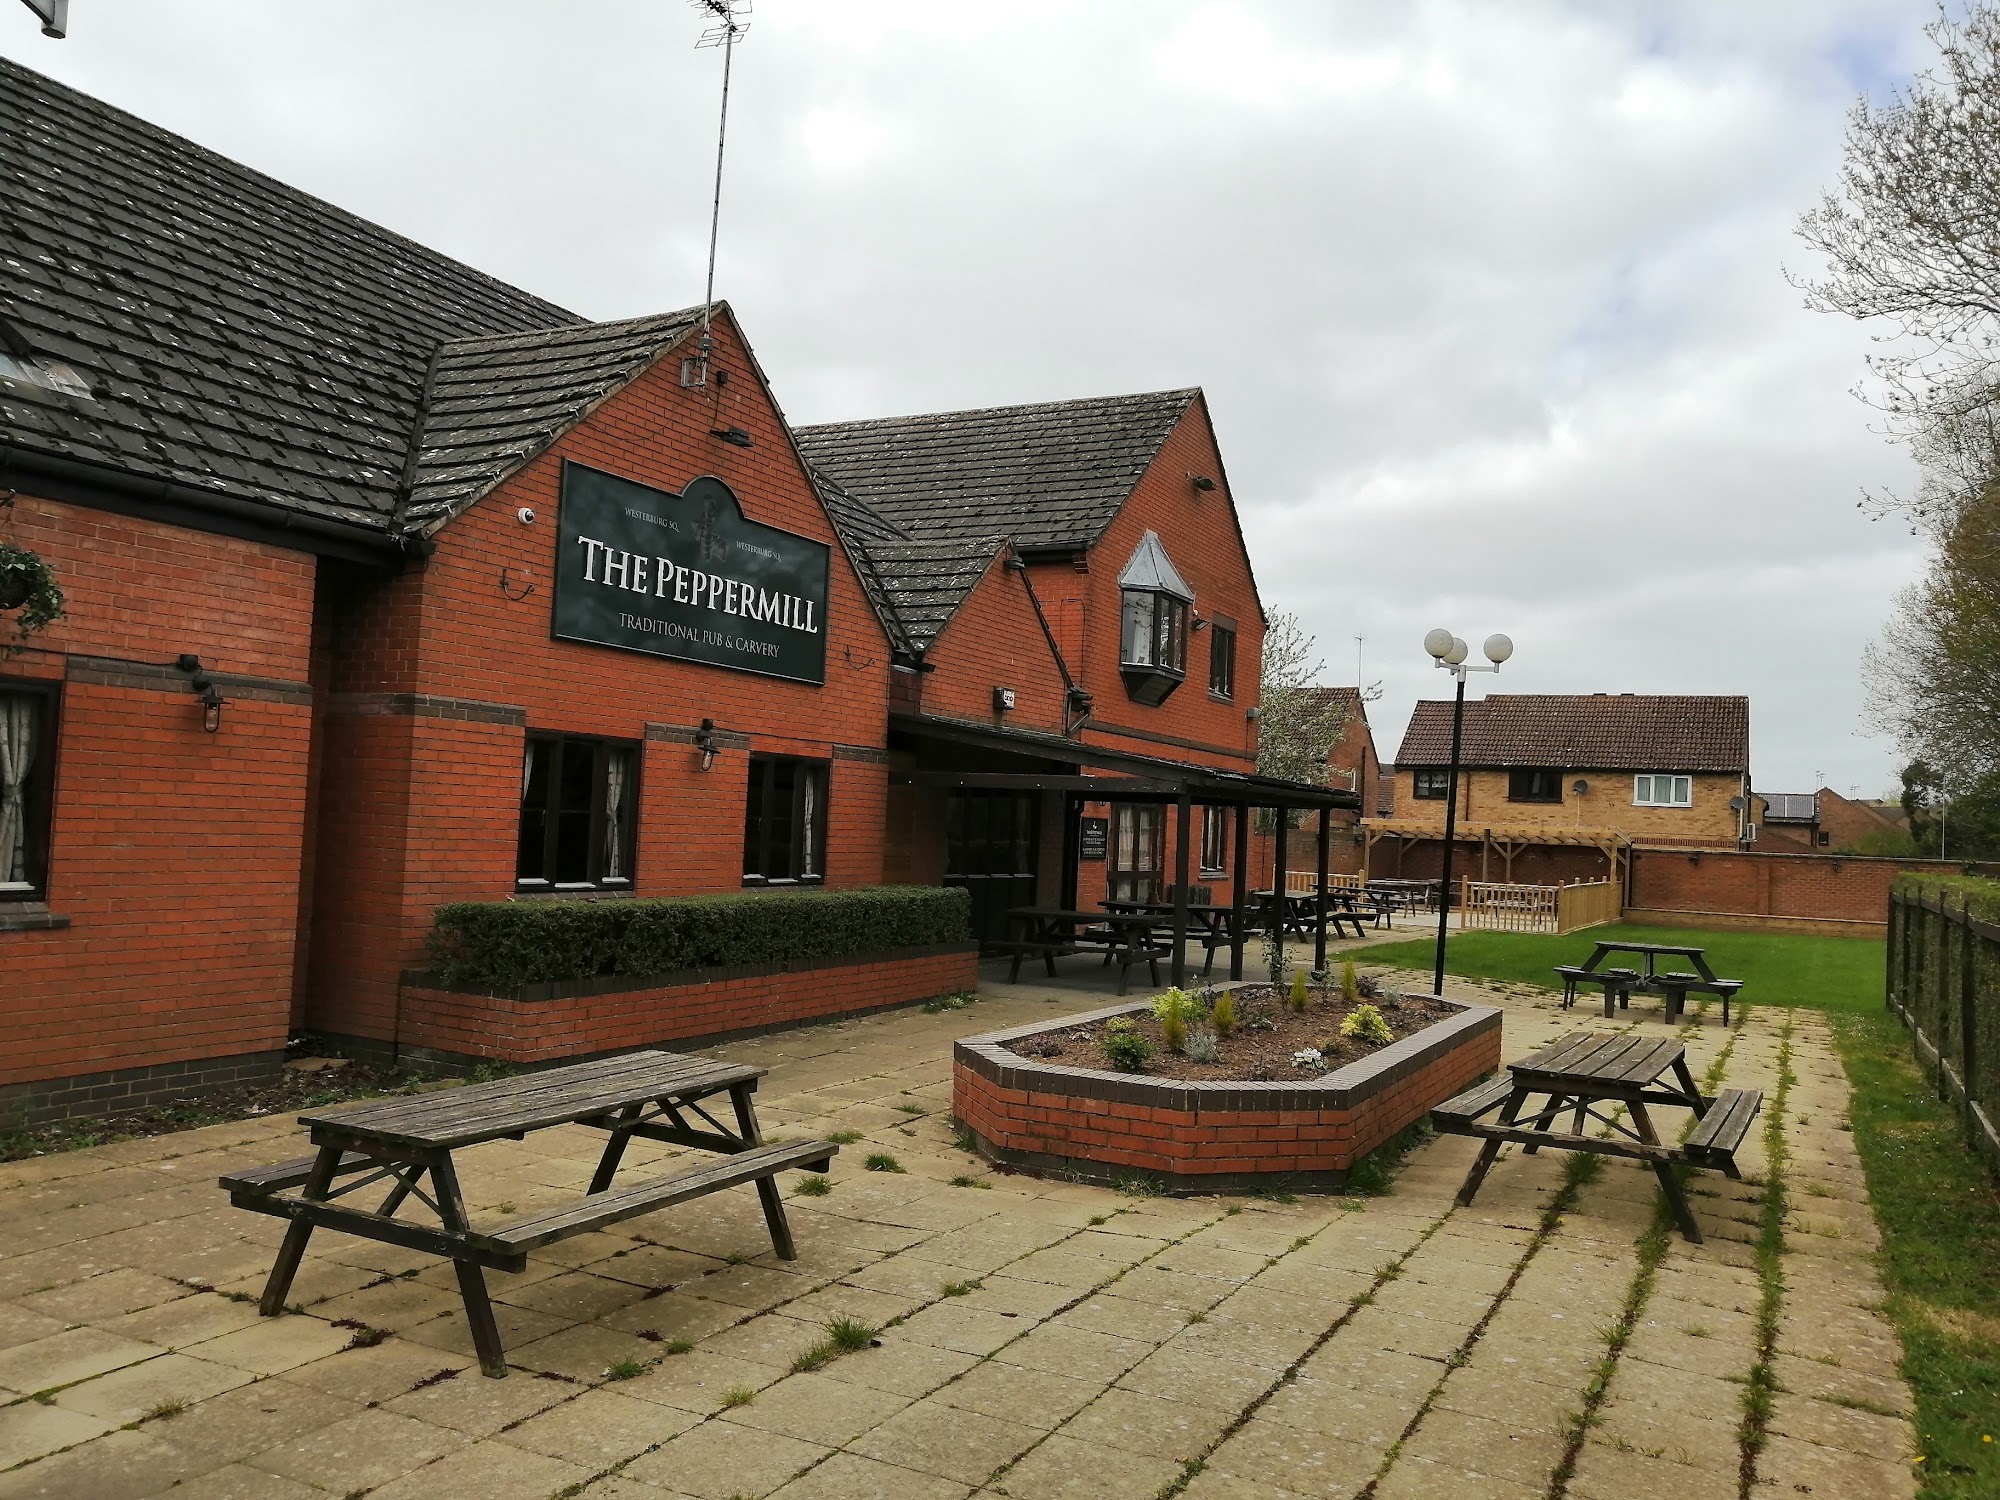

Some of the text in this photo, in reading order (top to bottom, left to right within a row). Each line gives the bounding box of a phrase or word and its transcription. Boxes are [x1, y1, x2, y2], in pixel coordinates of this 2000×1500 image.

[624, 507, 668, 528] WESTERBURG
[736, 540, 772, 558] WESTERBURG
[577, 535, 818, 634] THE PEPPERMILL
[619, 612, 781, 658] TRADITIONAL PUB & CARVERY
